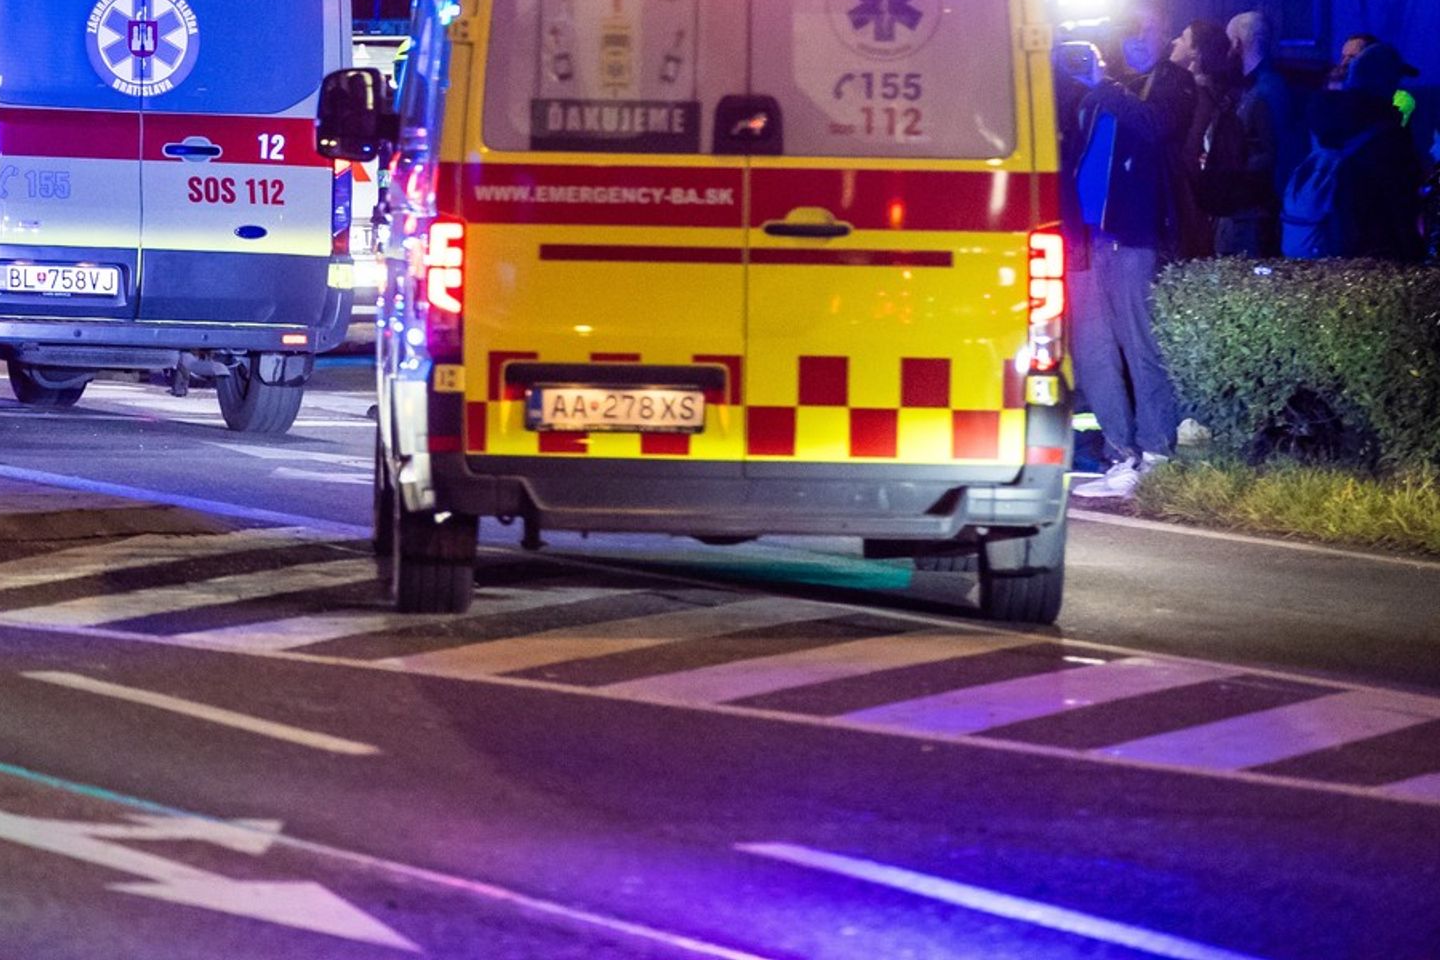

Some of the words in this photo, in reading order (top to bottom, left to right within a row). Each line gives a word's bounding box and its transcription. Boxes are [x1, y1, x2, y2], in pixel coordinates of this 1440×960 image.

[112, 78, 174, 97] BRATISLAVA
[861, 72, 923, 101] 155
[861, 107, 923, 136] 112
[258, 134, 285, 160] 12
[24, 170, 71, 199] 155
[188, 176, 237, 204] SOS
[245, 178, 285, 205] 112
[474, 185, 734, 205] WWW.EMERGENCY-BA.SK
